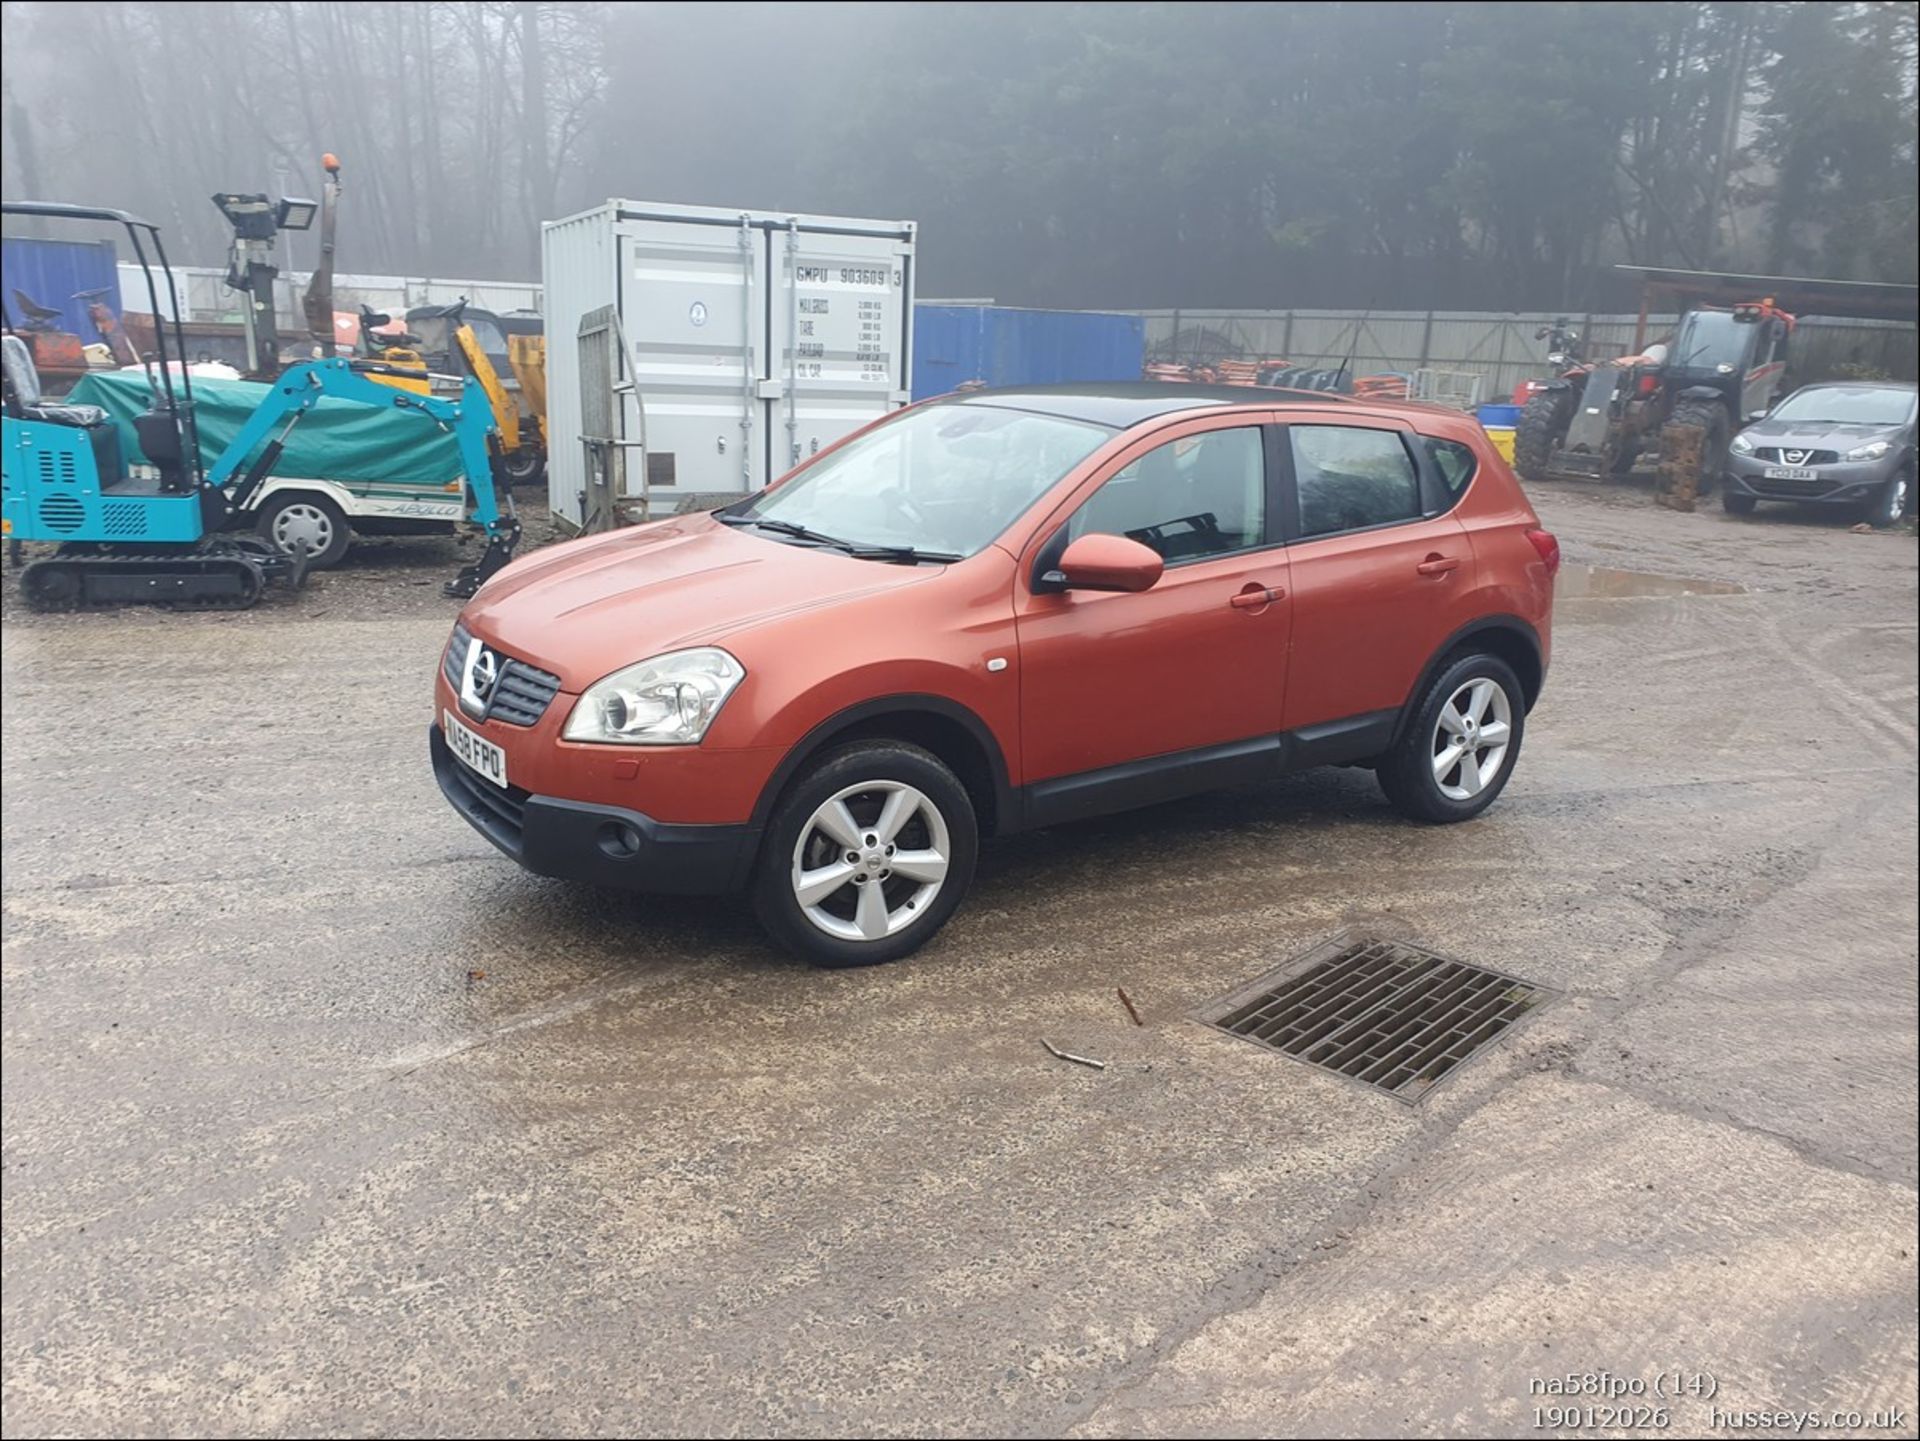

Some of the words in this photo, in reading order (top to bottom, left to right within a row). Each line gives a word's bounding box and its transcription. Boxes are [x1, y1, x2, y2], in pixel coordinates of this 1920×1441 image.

[796, 266, 828, 283] GMPU
[840, 268, 885, 285] 903609
[893, 270, 902, 287] 3
[391, 503, 459, 516] APOLLO
[473, 738, 500, 779] FPO
